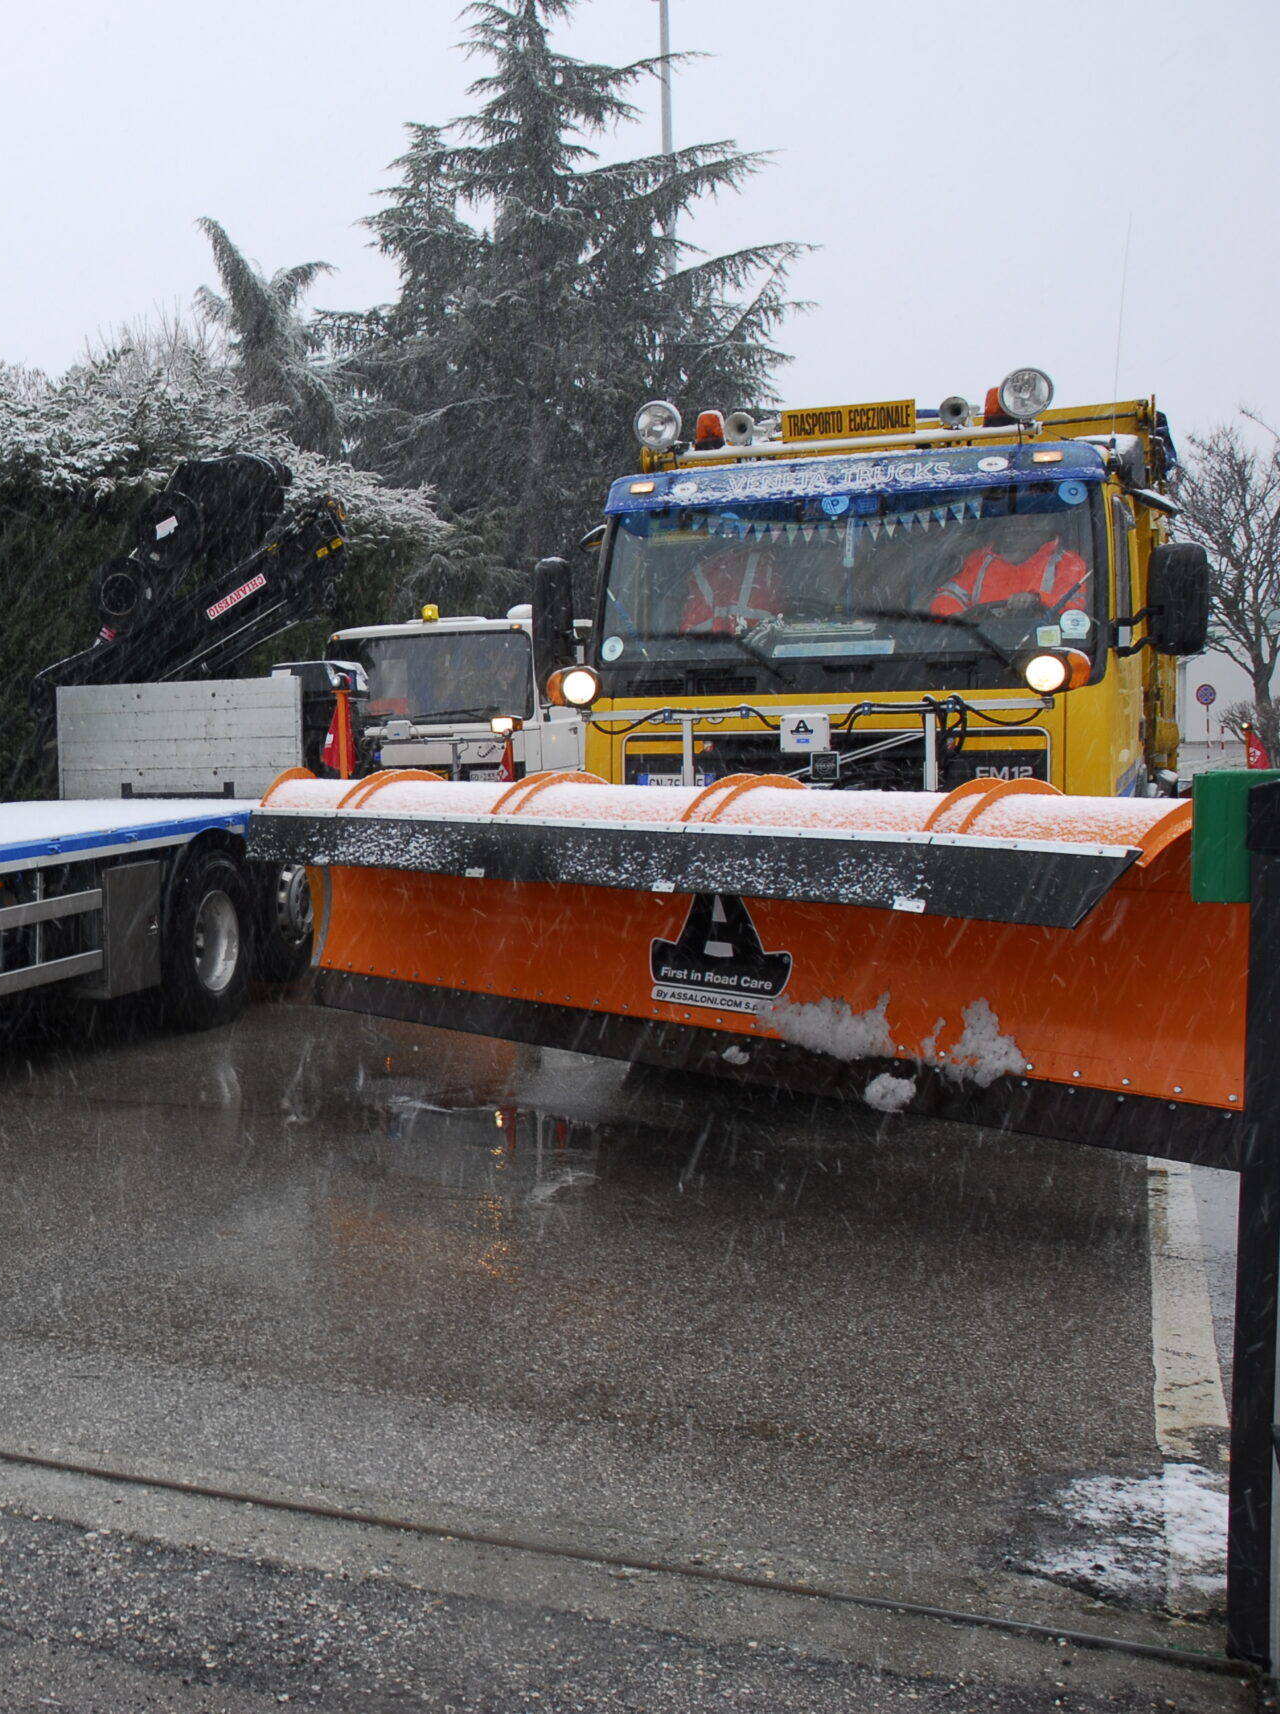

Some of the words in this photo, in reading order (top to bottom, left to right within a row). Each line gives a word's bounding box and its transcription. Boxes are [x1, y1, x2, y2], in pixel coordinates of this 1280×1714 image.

[787, 410, 843, 437] TRASPORTO
[848, 404, 911, 433] ECCEZIONALE
[842, 461, 951, 483] TRUCKS
[208, 575, 264, 617] CHIARVESIO
[975, 766, 1033, 782] FM12
[661, 966, 688, 980] First
[691, 970, 702, 981] in
[705, 972, 738, 986] Road
[741, 976, 773, 990] Care
[656, 989, 667, 1000] By
[669, 991, 742, 1009] ASSALONI.COM
